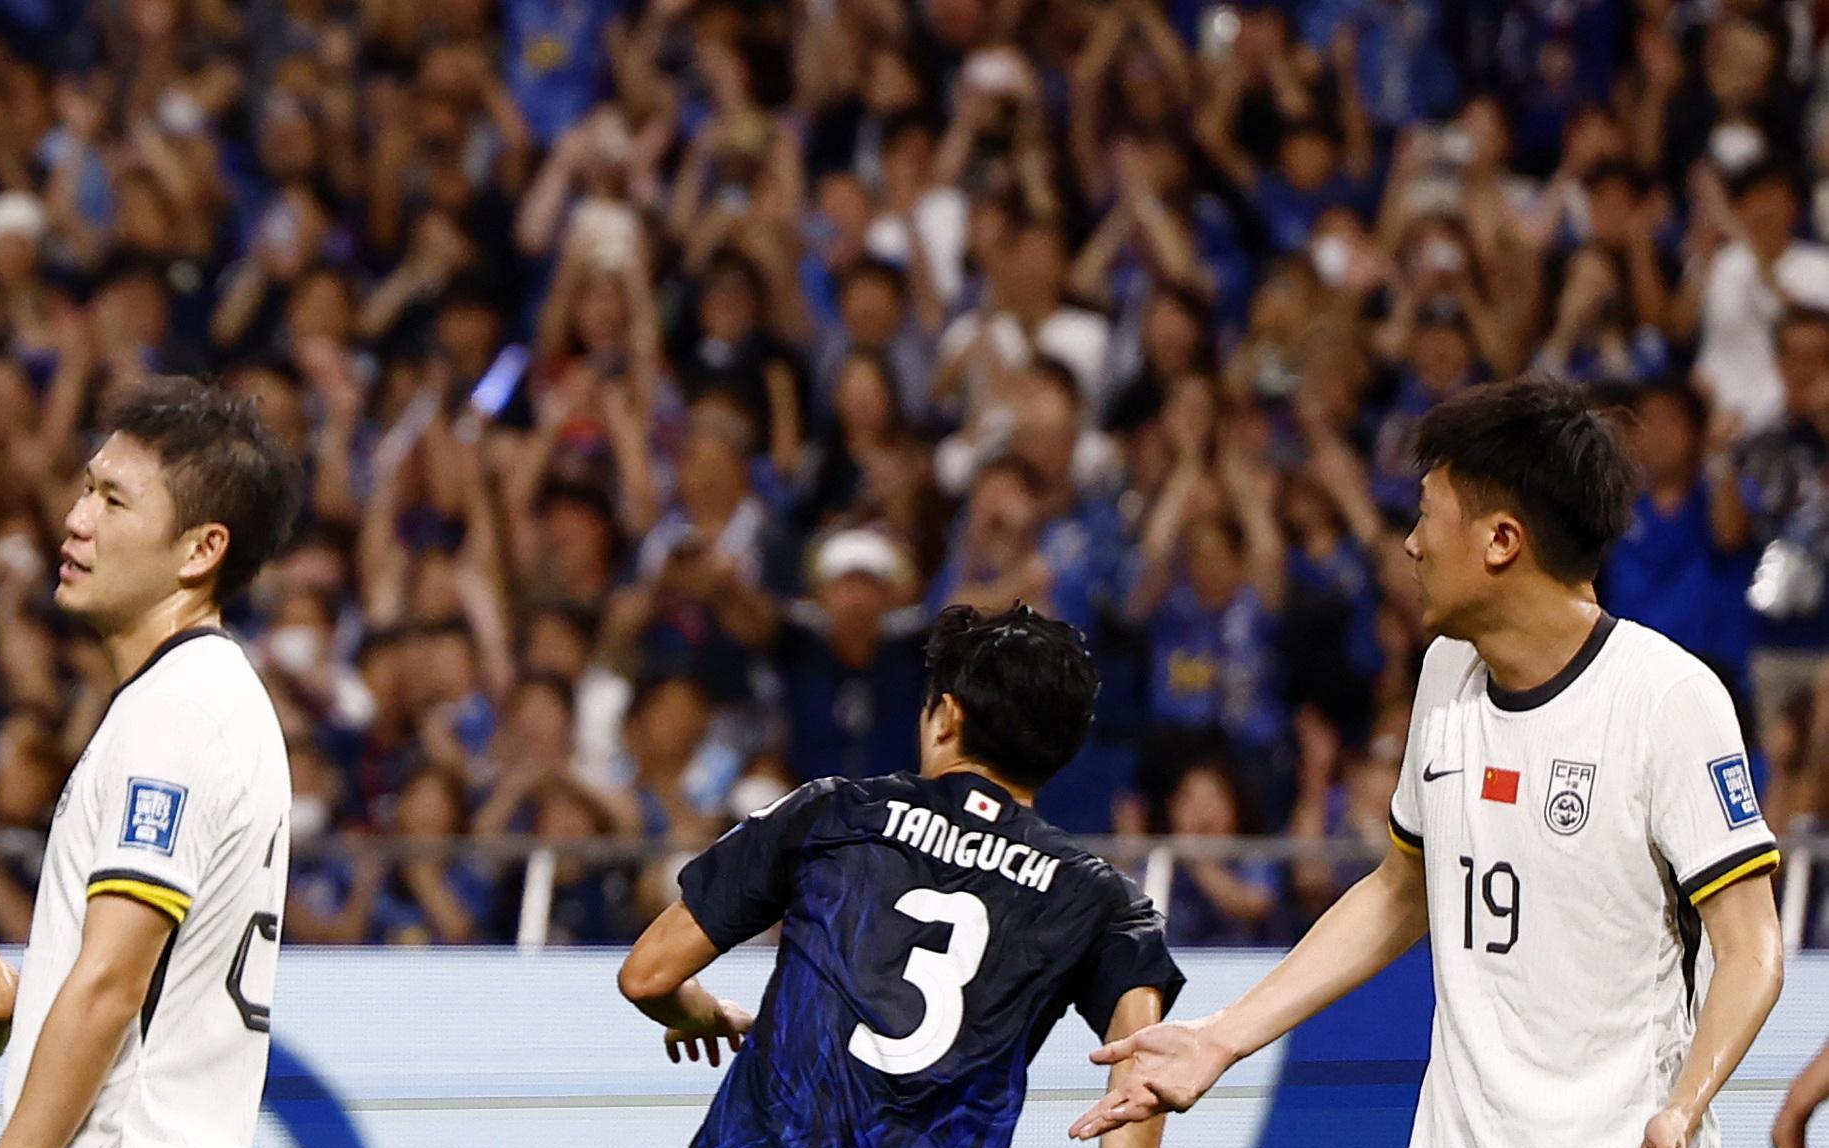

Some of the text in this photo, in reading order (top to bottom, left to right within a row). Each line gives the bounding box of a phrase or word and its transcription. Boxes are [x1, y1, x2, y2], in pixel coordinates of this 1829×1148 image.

[1555, 764, 1591, 782] CFA
[881, 800, 1061, 893] TANIGUCHI
[1459, 855, 1521, 955] 19
[847, 887, 991, 1076] 3
